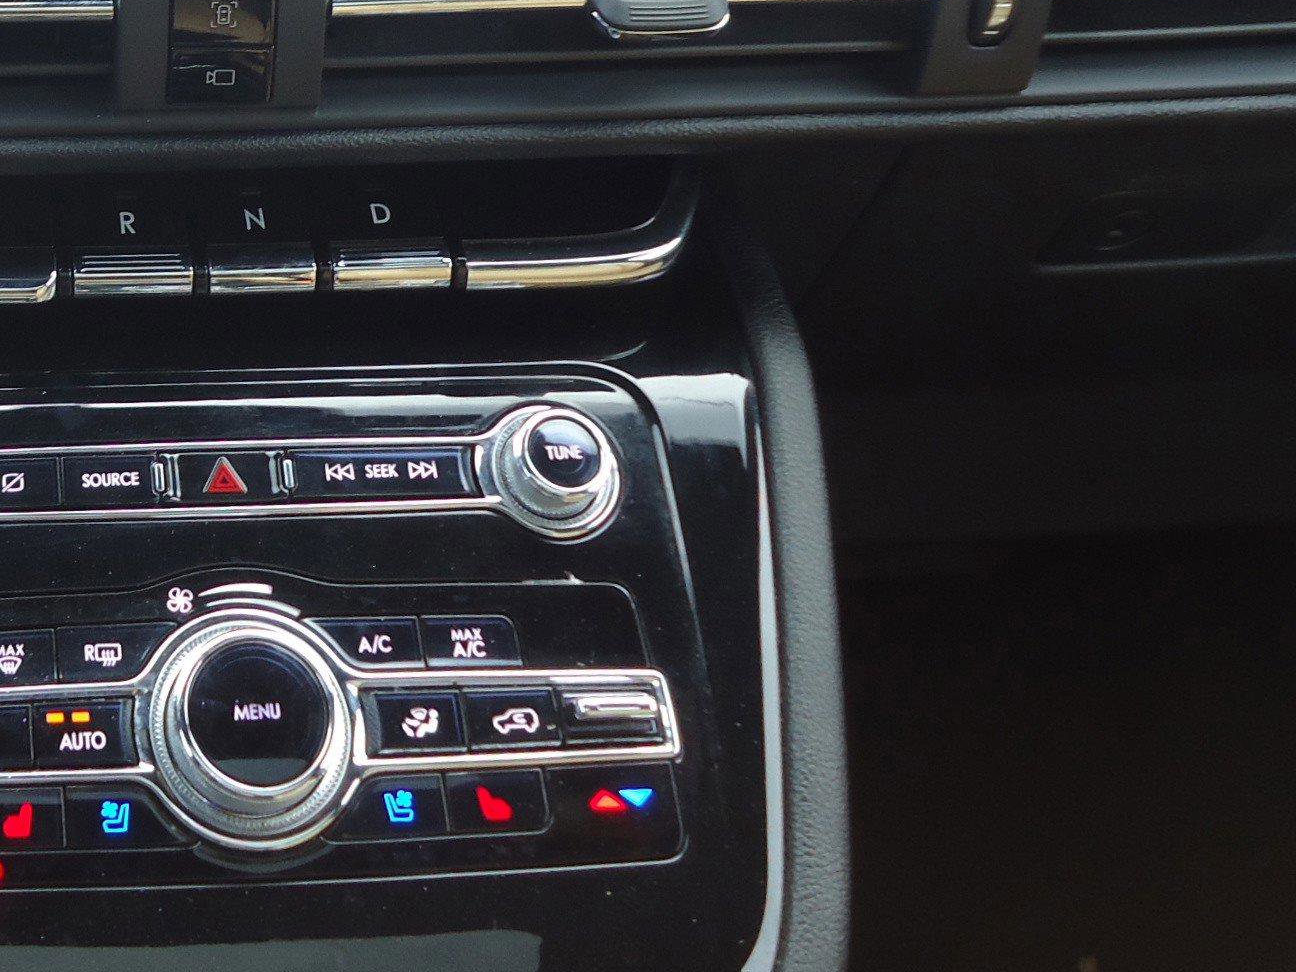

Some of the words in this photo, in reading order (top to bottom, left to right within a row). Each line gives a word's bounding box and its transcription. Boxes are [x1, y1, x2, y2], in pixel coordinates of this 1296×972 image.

[119, 210, 137, 235] R
[243, 207, 267, 231] N
[369, 202, 392, 225] D
[542, 444, 585, 462] TUNE
[81, 471, 140, 490] SOURCE
[364, 462, 400, 480] SEEK
[358, 634, 394, 655] A/C
[450, 627, 483, 643] MAX
[452, 640, 487, 660] A/C
[233, 701, 282, 723] MENU
[59, 730, 107, 753] AUTO
